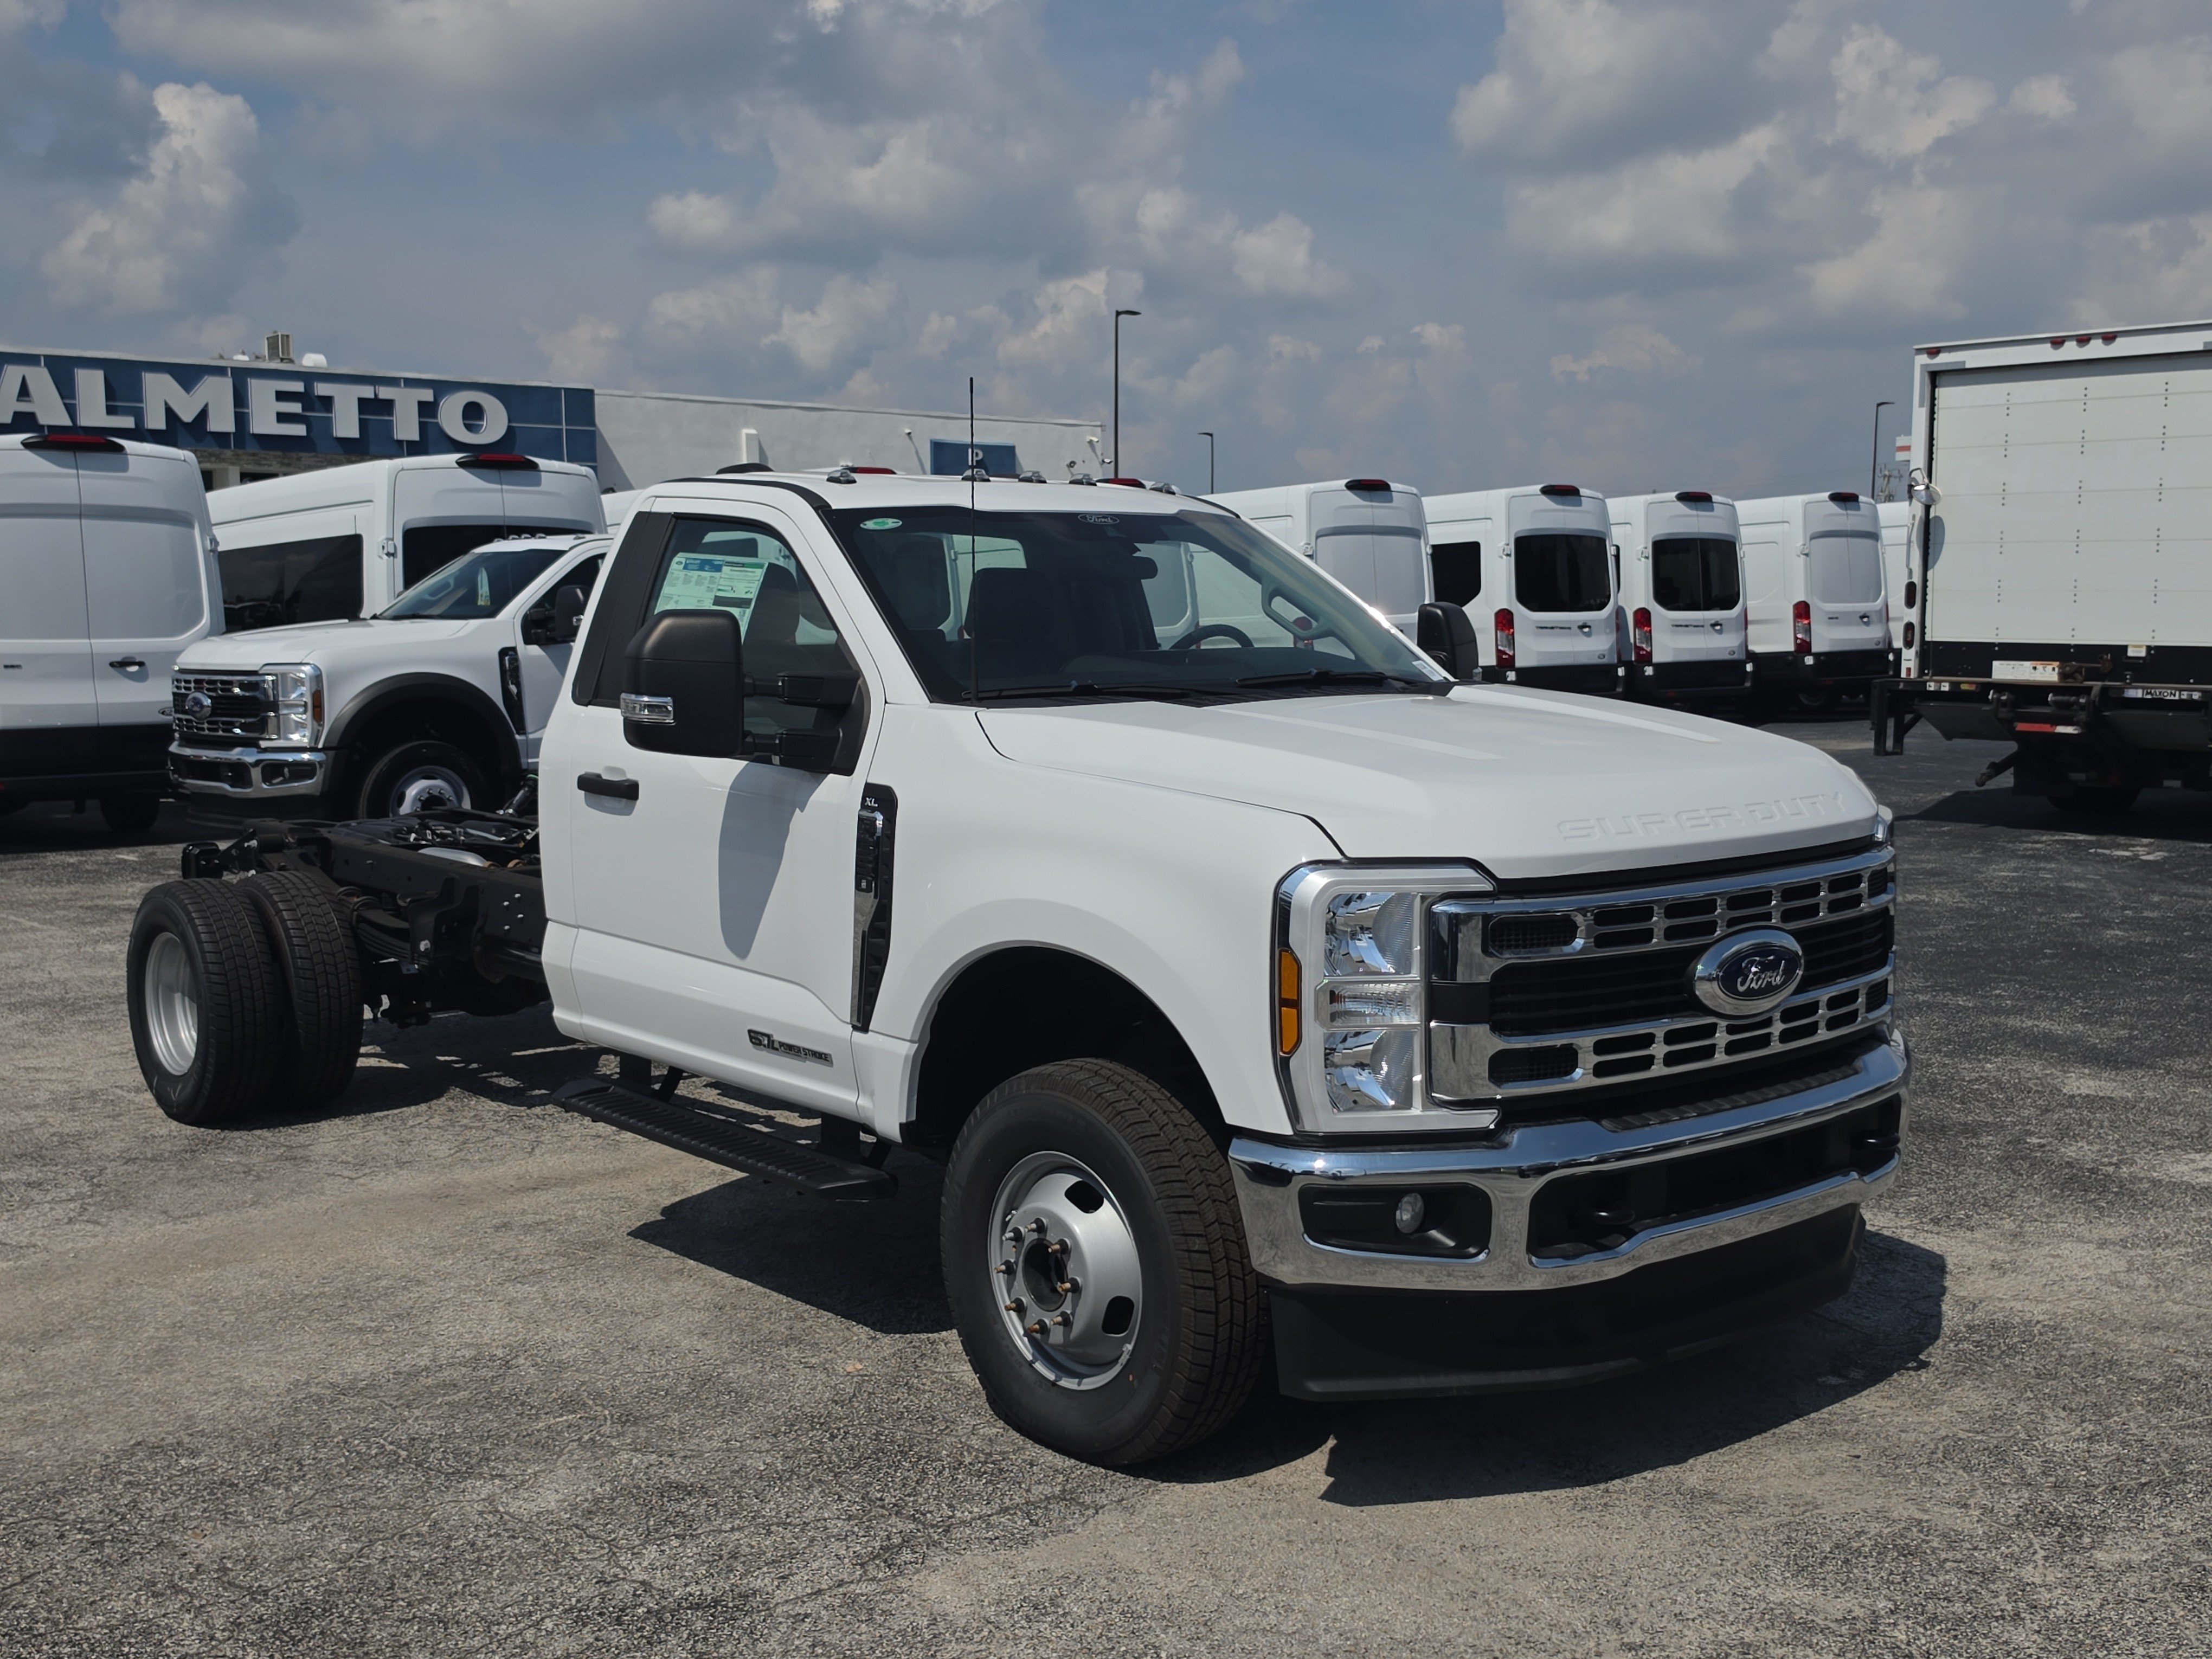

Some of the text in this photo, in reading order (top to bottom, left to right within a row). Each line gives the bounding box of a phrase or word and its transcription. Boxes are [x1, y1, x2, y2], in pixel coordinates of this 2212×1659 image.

[2145, 690, 2176, 698] MAXON
[865, 797, 878, 807] XL
[1555, 791, 1847, 843] SUPER DUTY
[1737, 955, 1786, 992] Ford
[747, 1029, 779, 1051] 6.7L
[802, 1047, 829, 1062] STROKE
